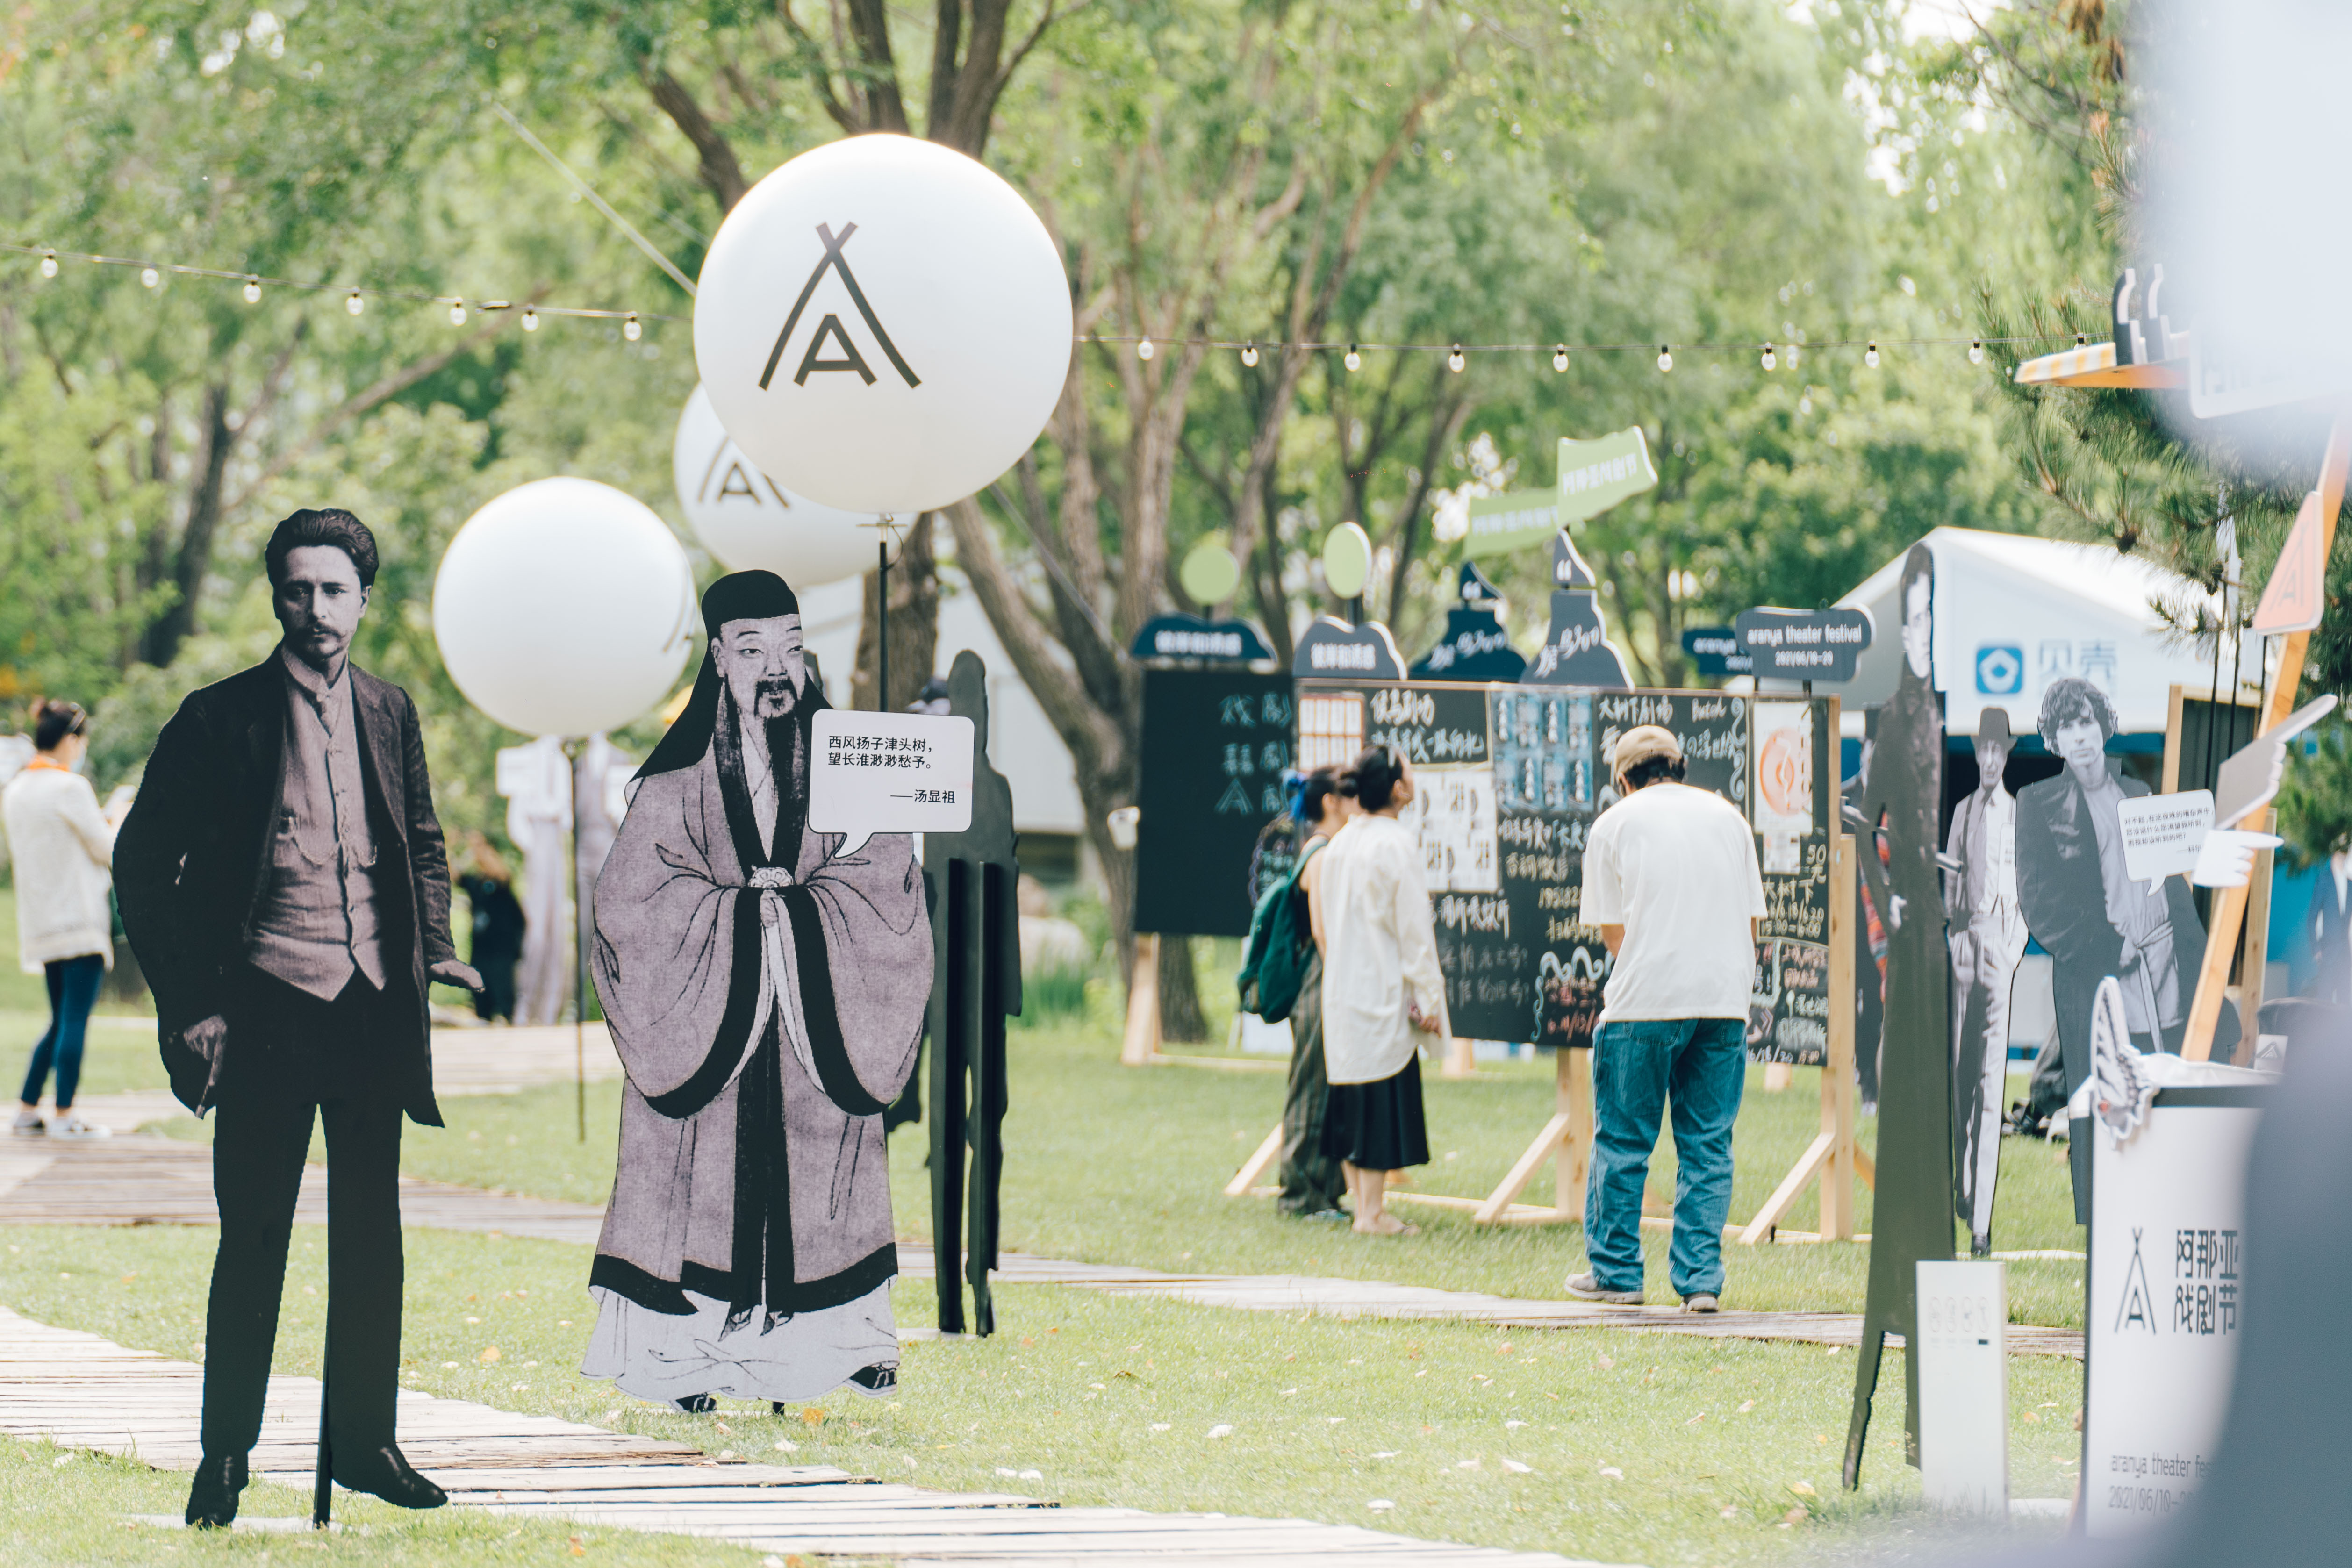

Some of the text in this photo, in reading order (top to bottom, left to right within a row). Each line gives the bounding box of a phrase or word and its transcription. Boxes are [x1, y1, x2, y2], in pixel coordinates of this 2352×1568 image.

[1747, 623, 1862, 647] aranya theater festival
[829, 736, 932, 753] 西风扬子津头树，
[828, 752, 932, 769] 望长淮渺渺愁予。
[1806, 844, 1827, 865] 50
[1811, 865, 1827, 884] 元
[2175, 1230, 2238, 1280] 阿那亚
[2173, 1283, 2238, 1335] 戏剧节
[2111, 1455, 2147, 1478] aranya
[2152, 1452, 2191, 1477] theater
